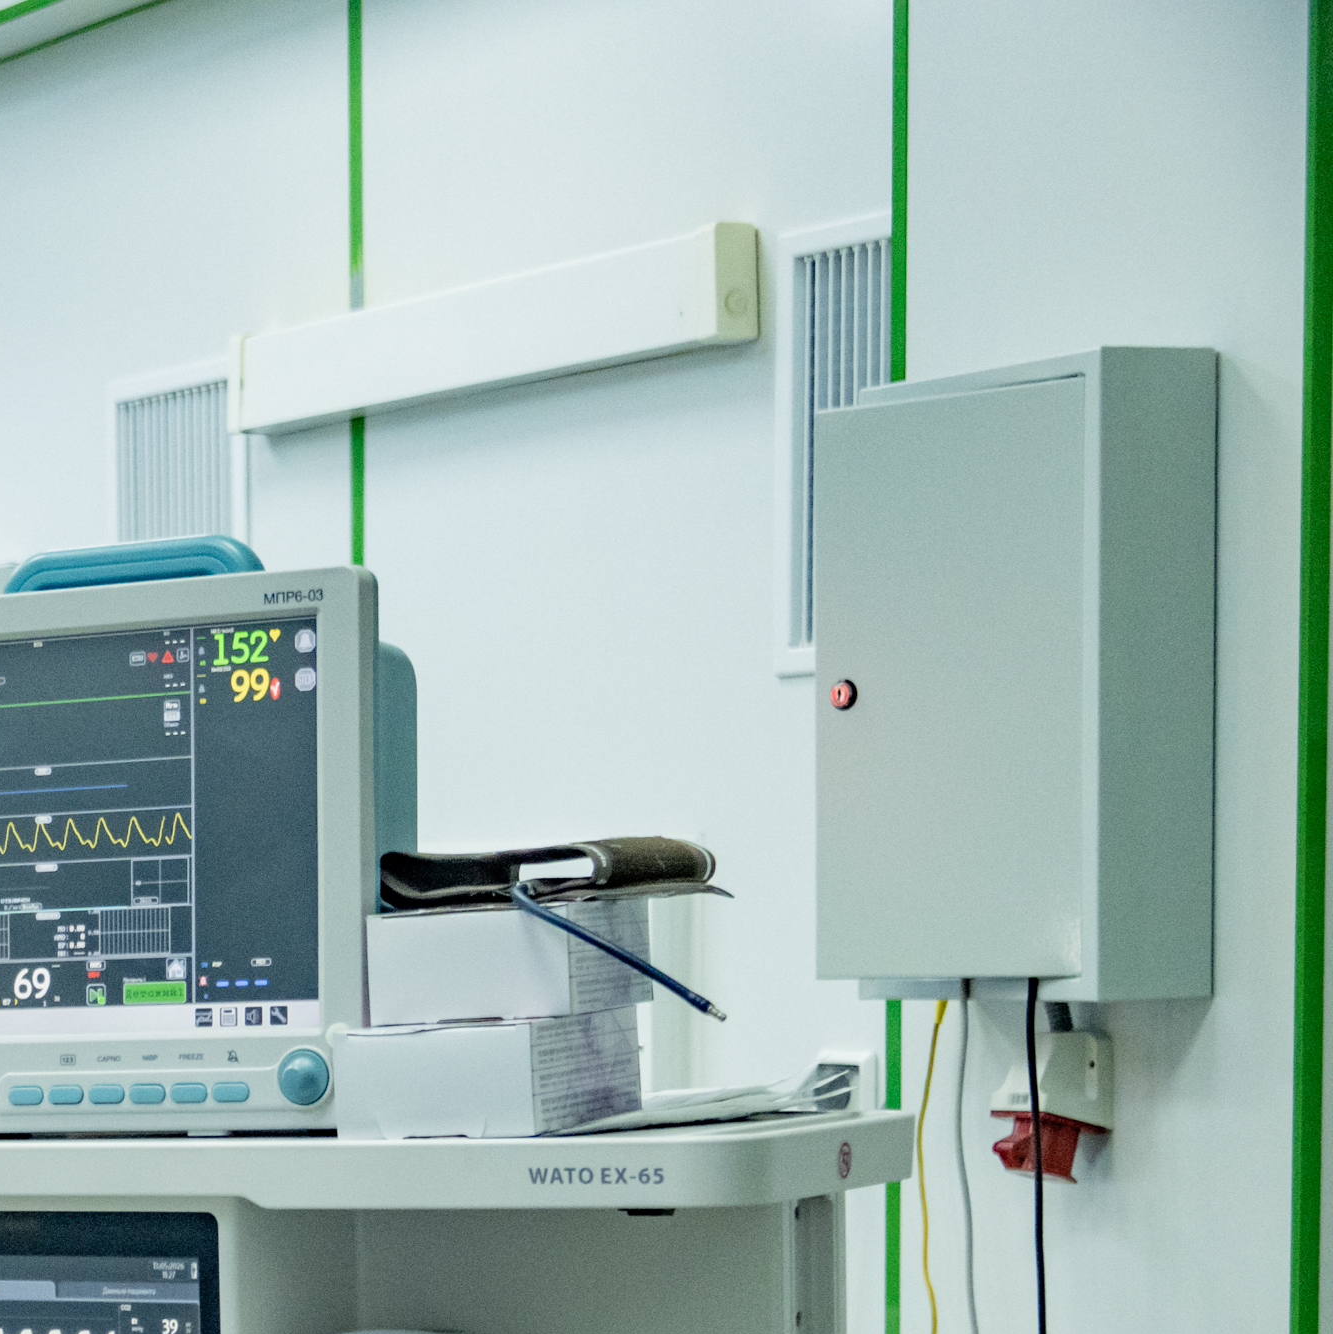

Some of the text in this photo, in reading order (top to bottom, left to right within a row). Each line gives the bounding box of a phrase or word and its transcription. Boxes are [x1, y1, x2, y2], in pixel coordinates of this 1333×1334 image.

[263, 589, 324, 605] МПР6-03
[213, 630, 269, 666] 152
[231, 667, 270, 703] 99
[14, 967, 51, 1000] 69
[178, 1053, 204, 1061] FREEZE
[528, 1167, 665, 1185] WATO EX-65
[162, 1318, 179, 1334] 39
